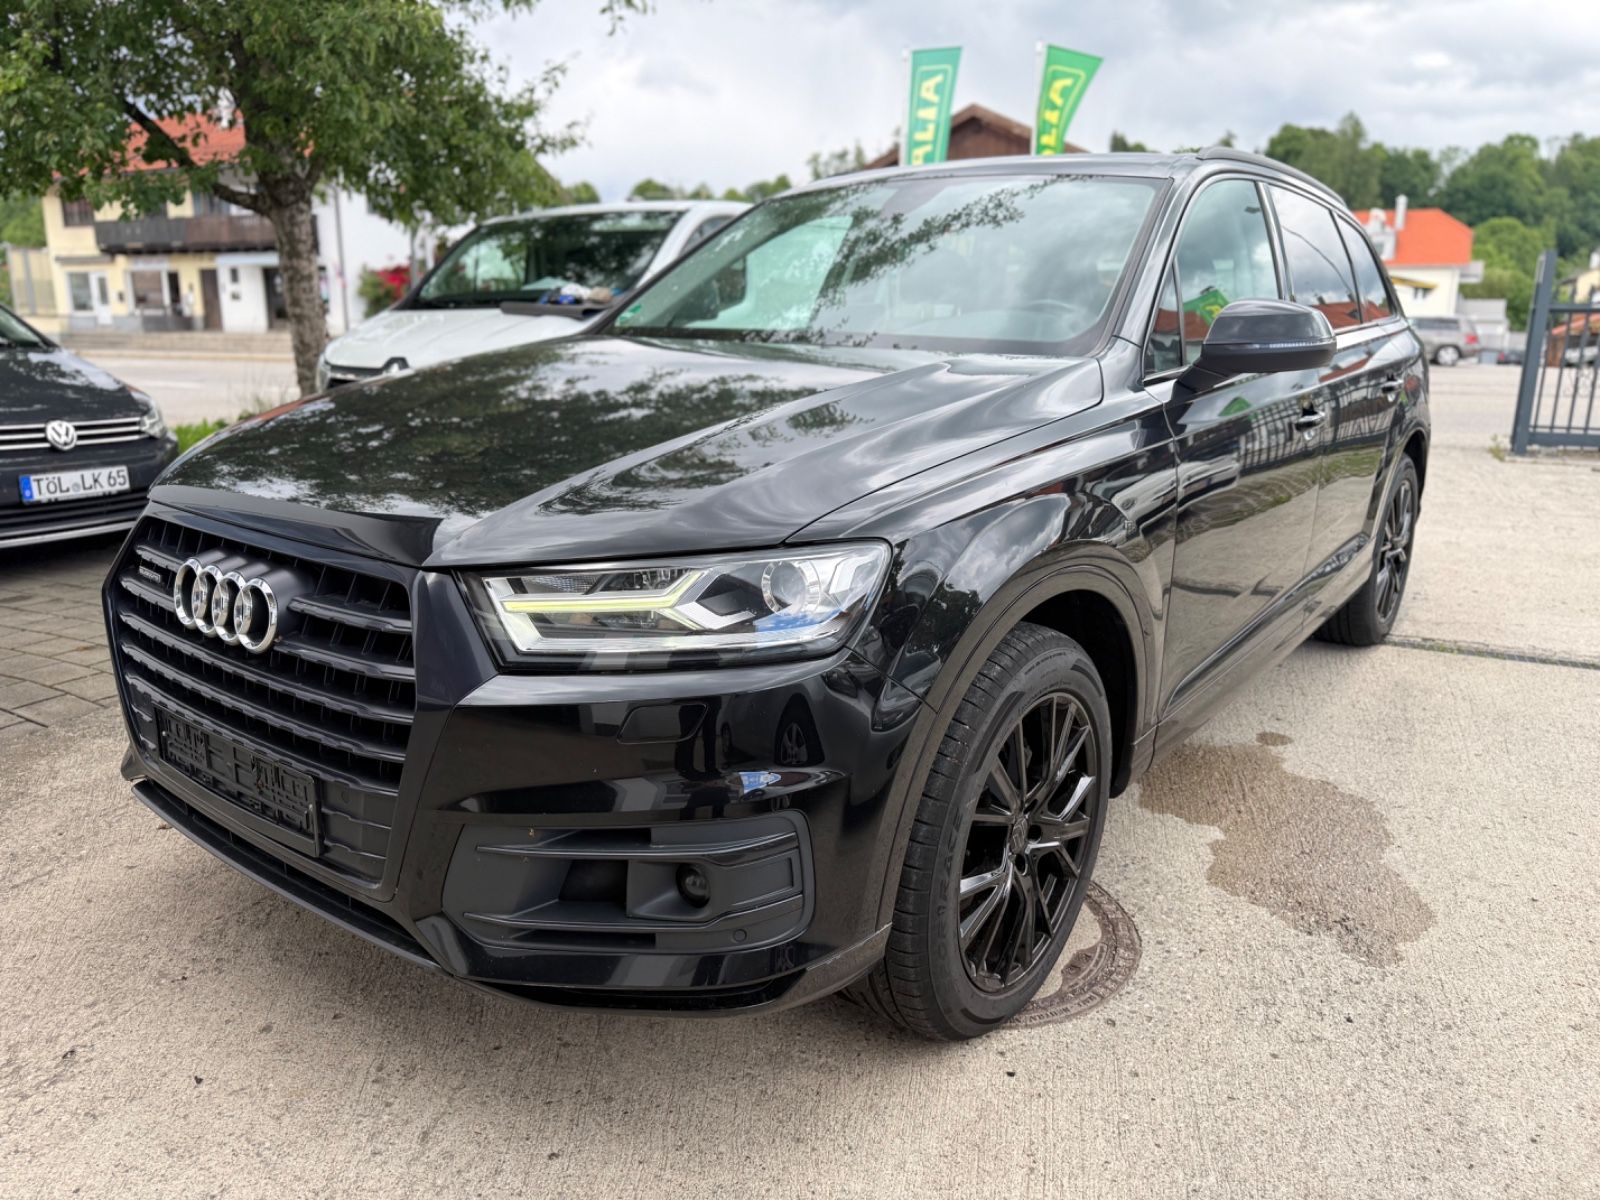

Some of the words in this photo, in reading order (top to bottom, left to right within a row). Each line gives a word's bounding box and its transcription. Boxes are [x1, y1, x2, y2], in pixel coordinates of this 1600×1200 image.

[33, 473, 70, 496] TÖL
[80, 472, 104, 491] LK
[107, 469, 127, 488] 65
